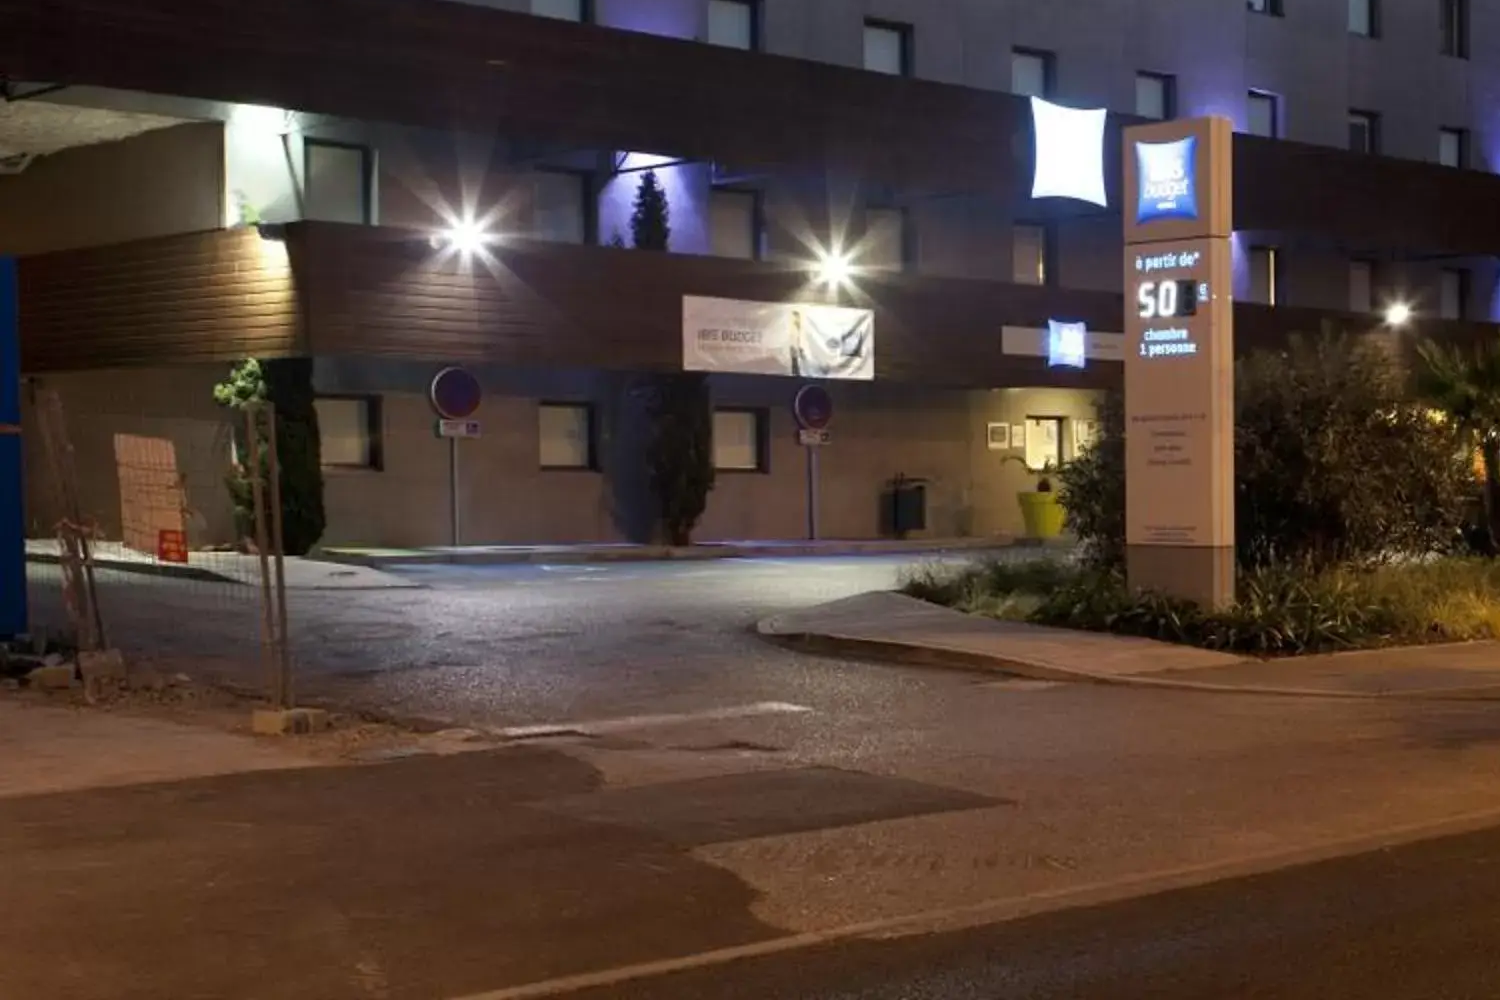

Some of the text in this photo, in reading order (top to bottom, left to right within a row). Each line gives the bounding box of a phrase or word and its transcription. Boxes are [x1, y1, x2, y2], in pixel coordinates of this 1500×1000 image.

[1143, 178, 1188, 201] budget
[1145, 251, 1177, 273] partir
[1139, 281, 1177, 318] 50
[1139, 342, 1197, 358] 1 personne
